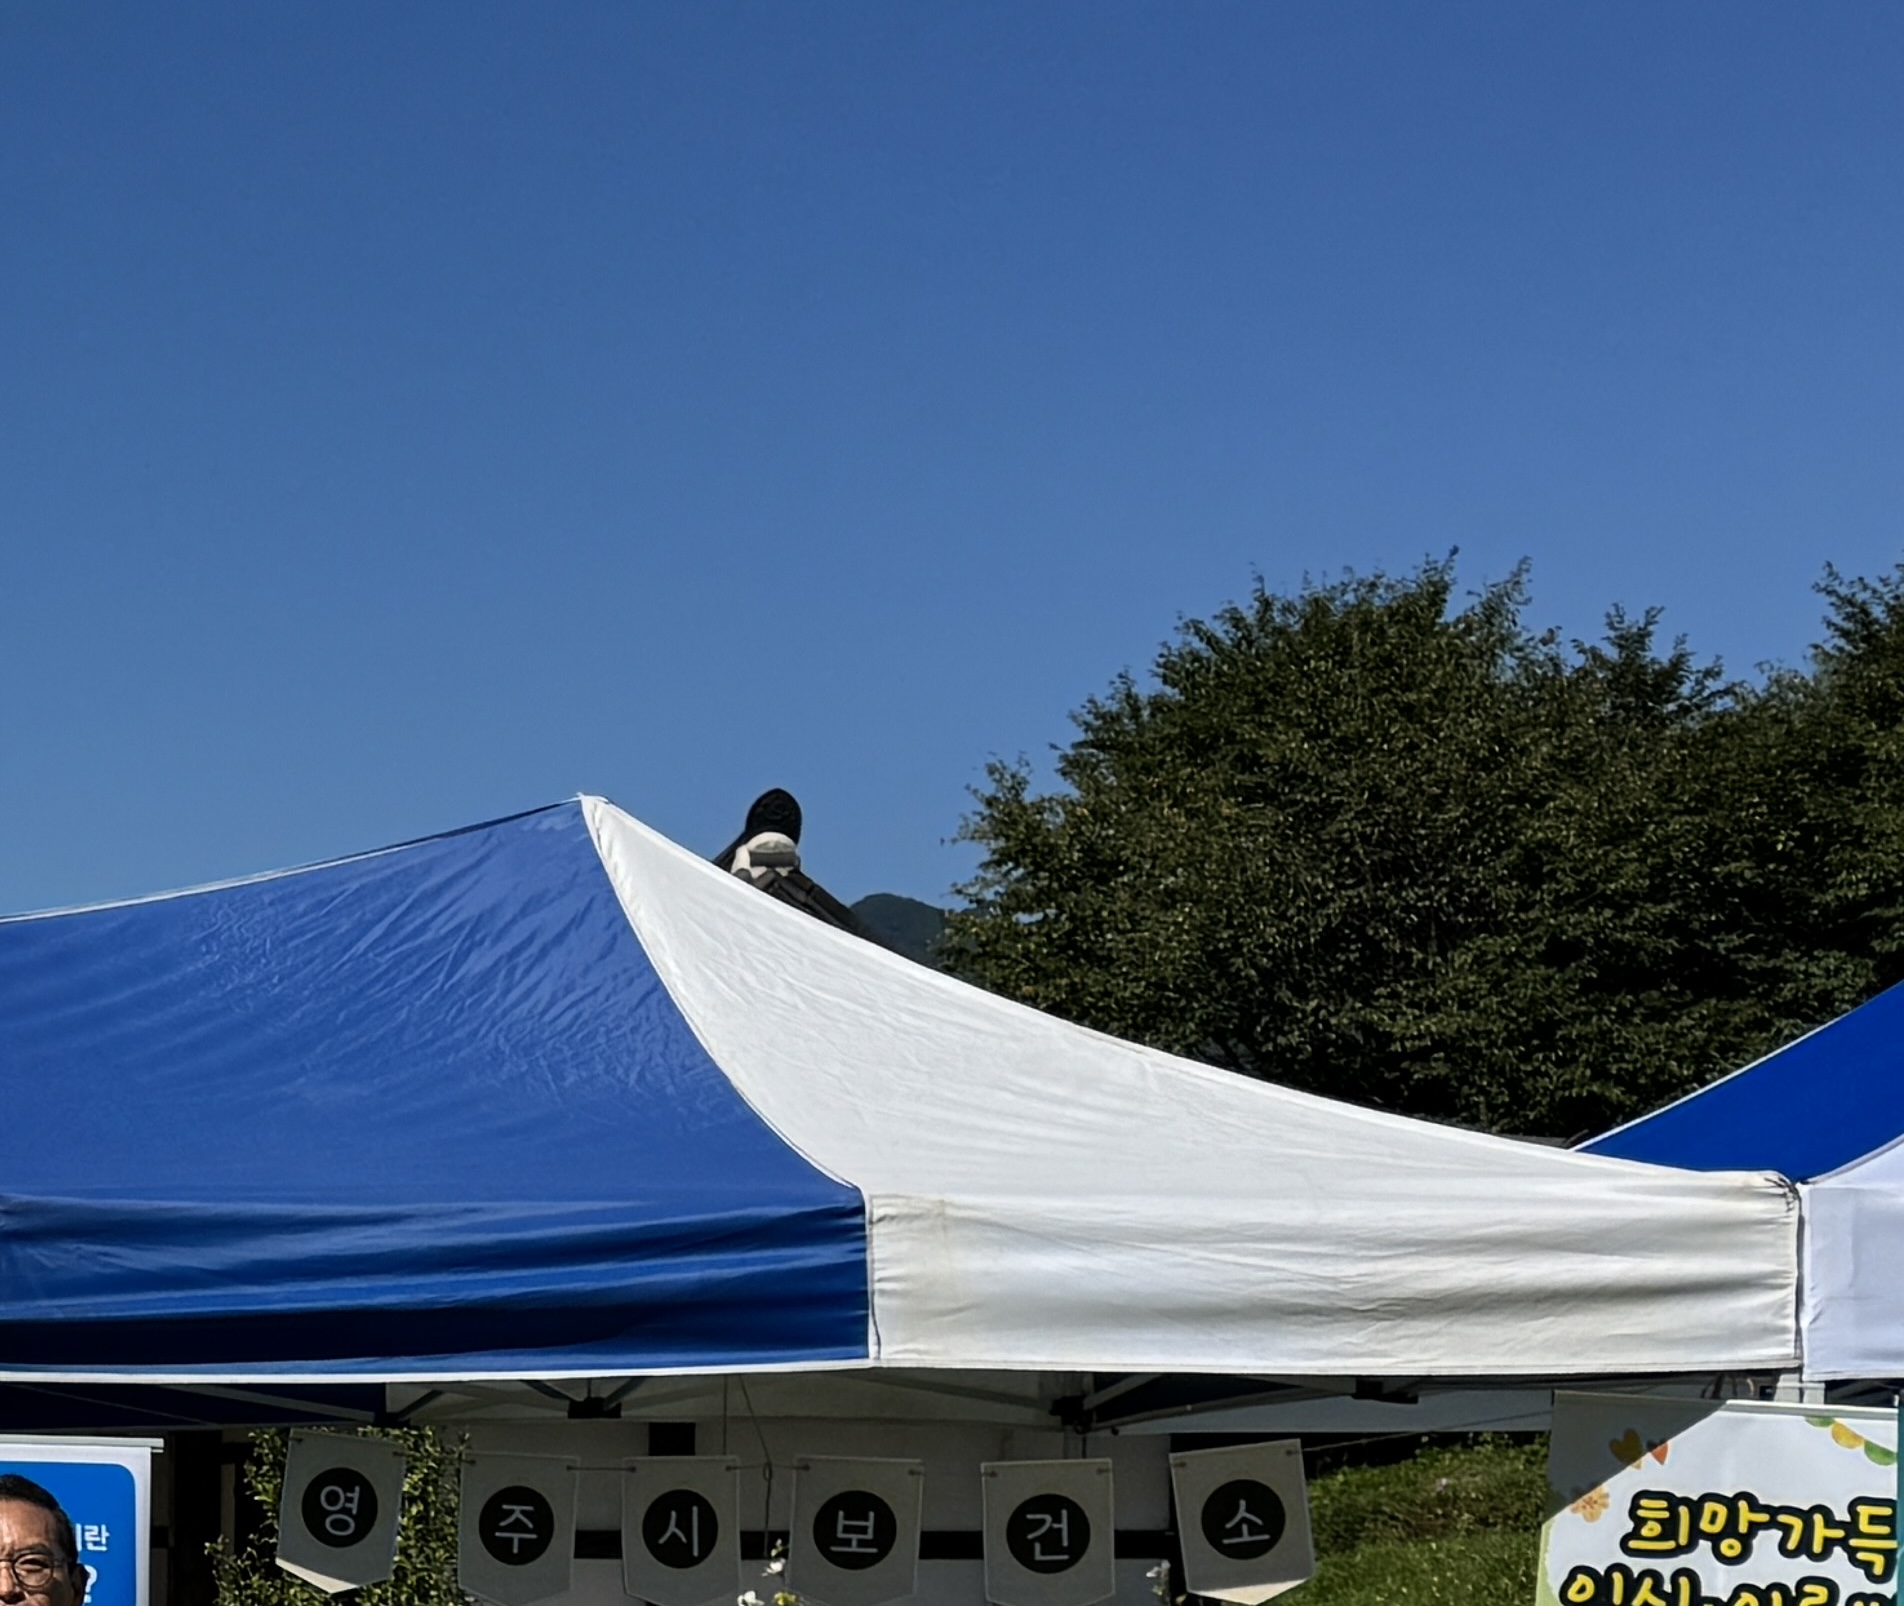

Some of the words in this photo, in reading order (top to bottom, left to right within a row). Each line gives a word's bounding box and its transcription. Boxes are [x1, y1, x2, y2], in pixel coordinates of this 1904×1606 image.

[318, 1484, 361, 1535] 영
[494, 1504, 541, 1555] 주
[659, 1507, 702, 1559] 시
[831, 1509, 881, 1556] 보
[1026, 1511, 1071, 1562] 건
[1221, 1499, 1272, 1543] 소
[1628, 1498, 1898, 1576] 희망가득
